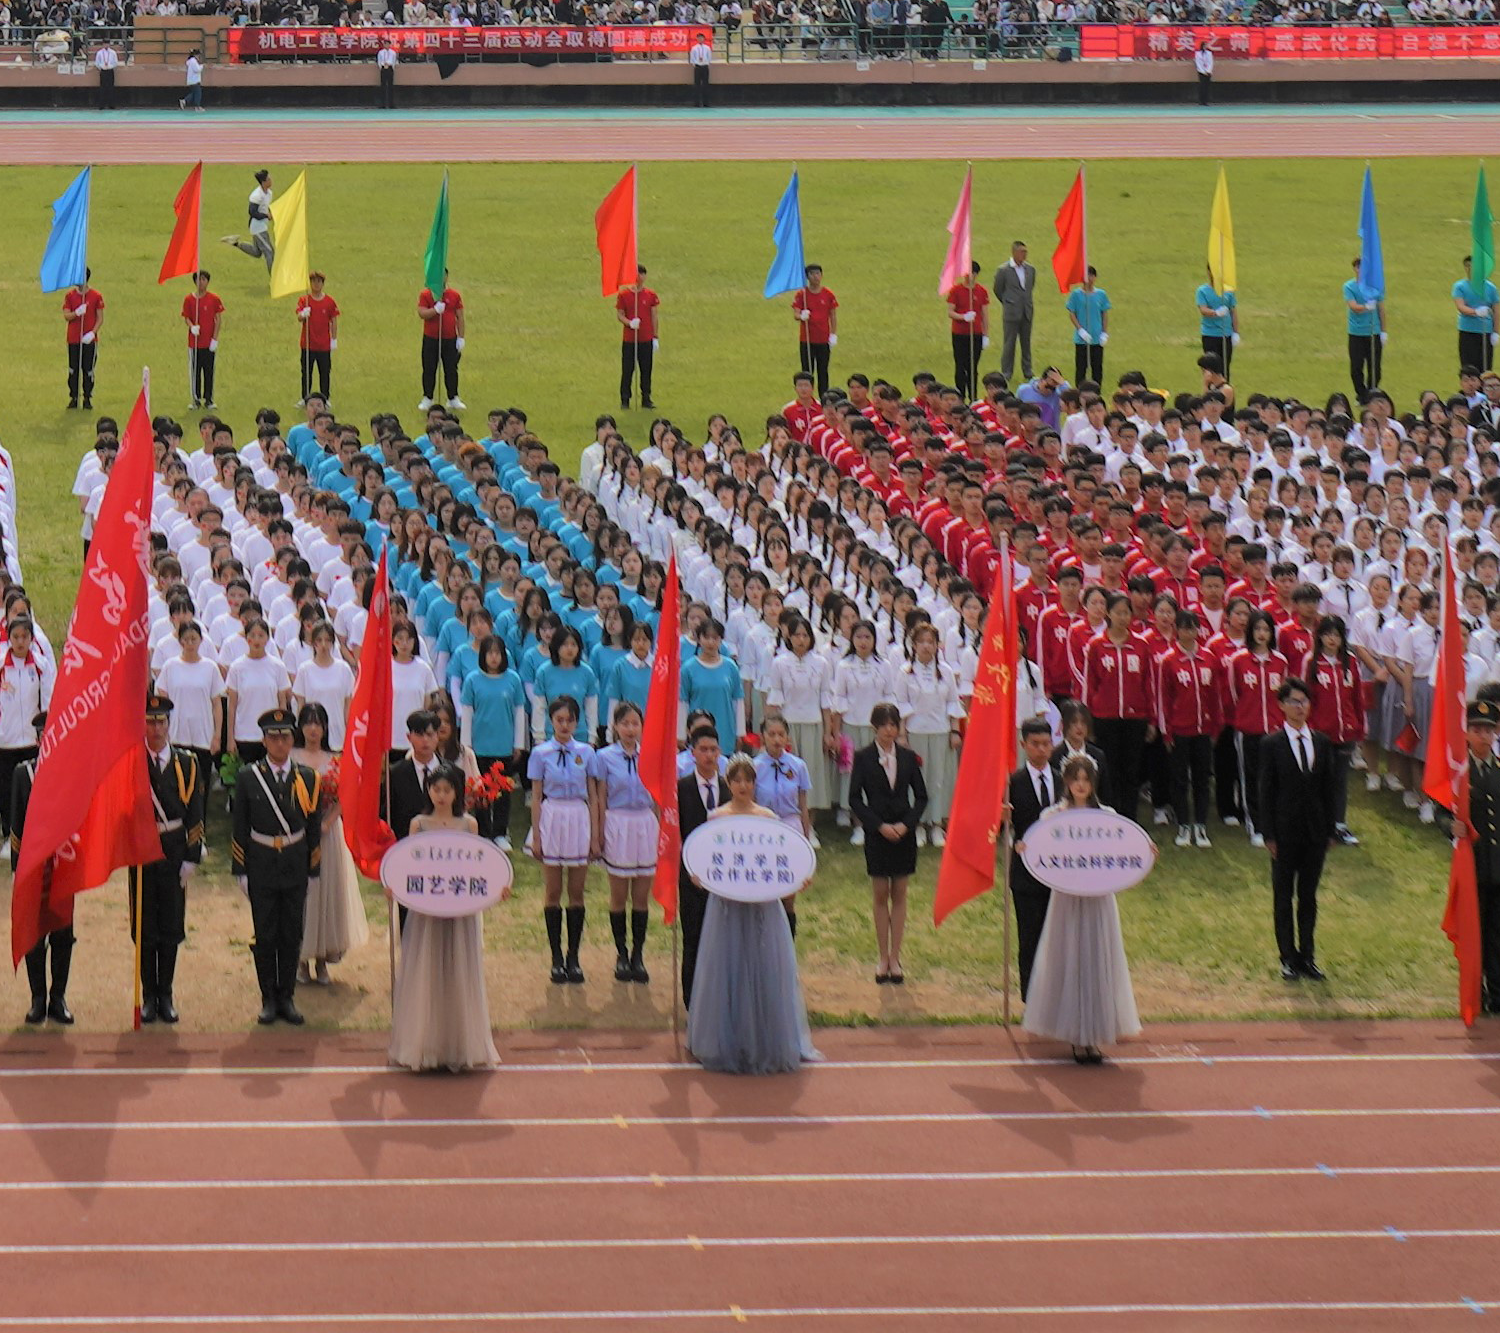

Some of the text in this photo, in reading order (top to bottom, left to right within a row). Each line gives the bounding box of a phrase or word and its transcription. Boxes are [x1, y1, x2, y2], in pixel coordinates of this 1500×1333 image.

[711, 852, 789, 868] 经济学院
[1038, 854, 1143, 870] 人文社会科学学院
[406, 875, 488, 897] 园艺学院
